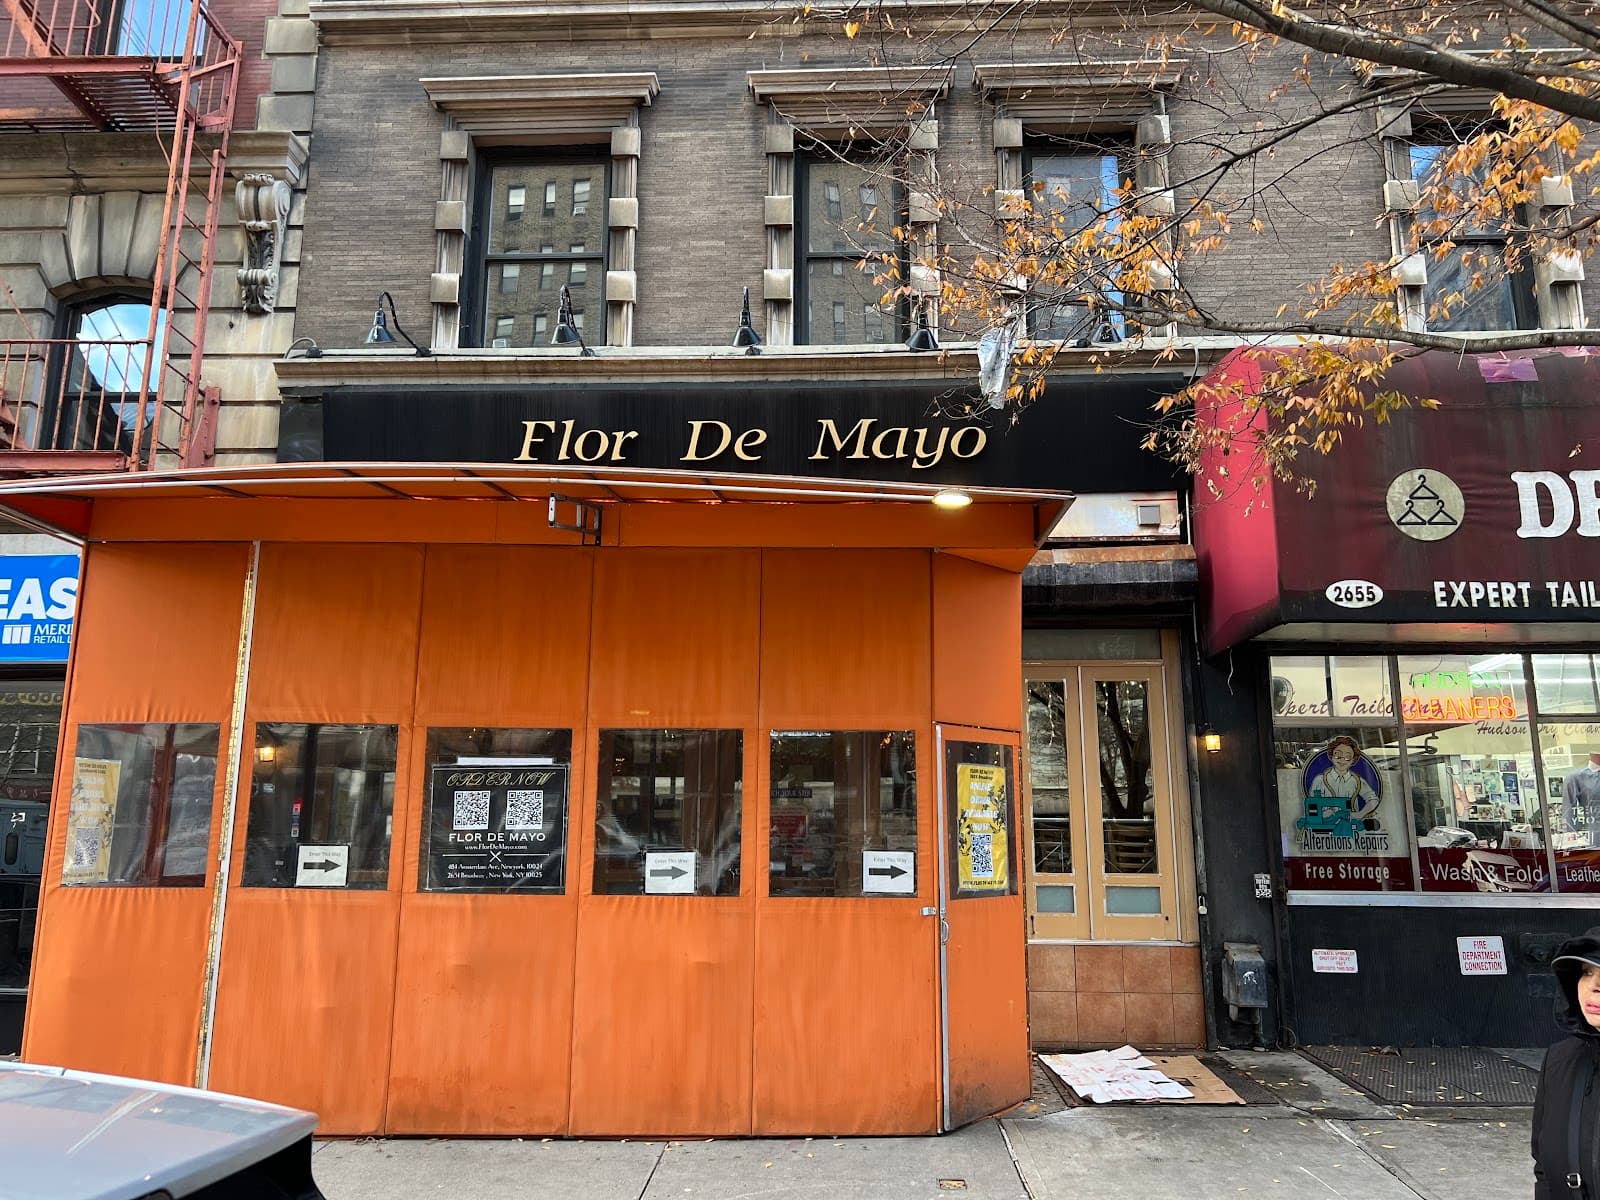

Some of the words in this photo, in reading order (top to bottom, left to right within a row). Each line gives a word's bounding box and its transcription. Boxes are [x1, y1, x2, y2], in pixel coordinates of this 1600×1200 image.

[512, 419, 639, 462] Flor
[679, 419, 768, 462] De
[807, 417, 988, 469] Mayo
[1333, 585, 1377, 603] 2655
[1433, 580, 1532, 609] EXPERT
[33, 635, 64, 644] RETAIL
[1402, 695, 1518, 720] CLEANERS
[1474, 719, 1528, 735] Hudson
[446, 771, 512, 787] ORDER
[510, 771, 556, 786] NOW
[448, 833, 482, 842] FLOR
[487, 832, 505, 842] DE
[509, 832, 546, 842] MAYO
[1303, 829, 1352, 851] Alterations
[1353, 830, 1389, 855] Repairs
[1305, 863, 1334, 879] Free
[1338, 863, 1390, 883] Storage
[1430, 863, 1482, 882] Wash
[1487, 865, 1499, 882] &
[1504, 864, 1544, 882] Fold
[1473, 940, 1487, 949] FIRE
[1462, 951, 1501, 960] DEPARTMENT
[1464, 961, 1503, 970] CONNECTION
